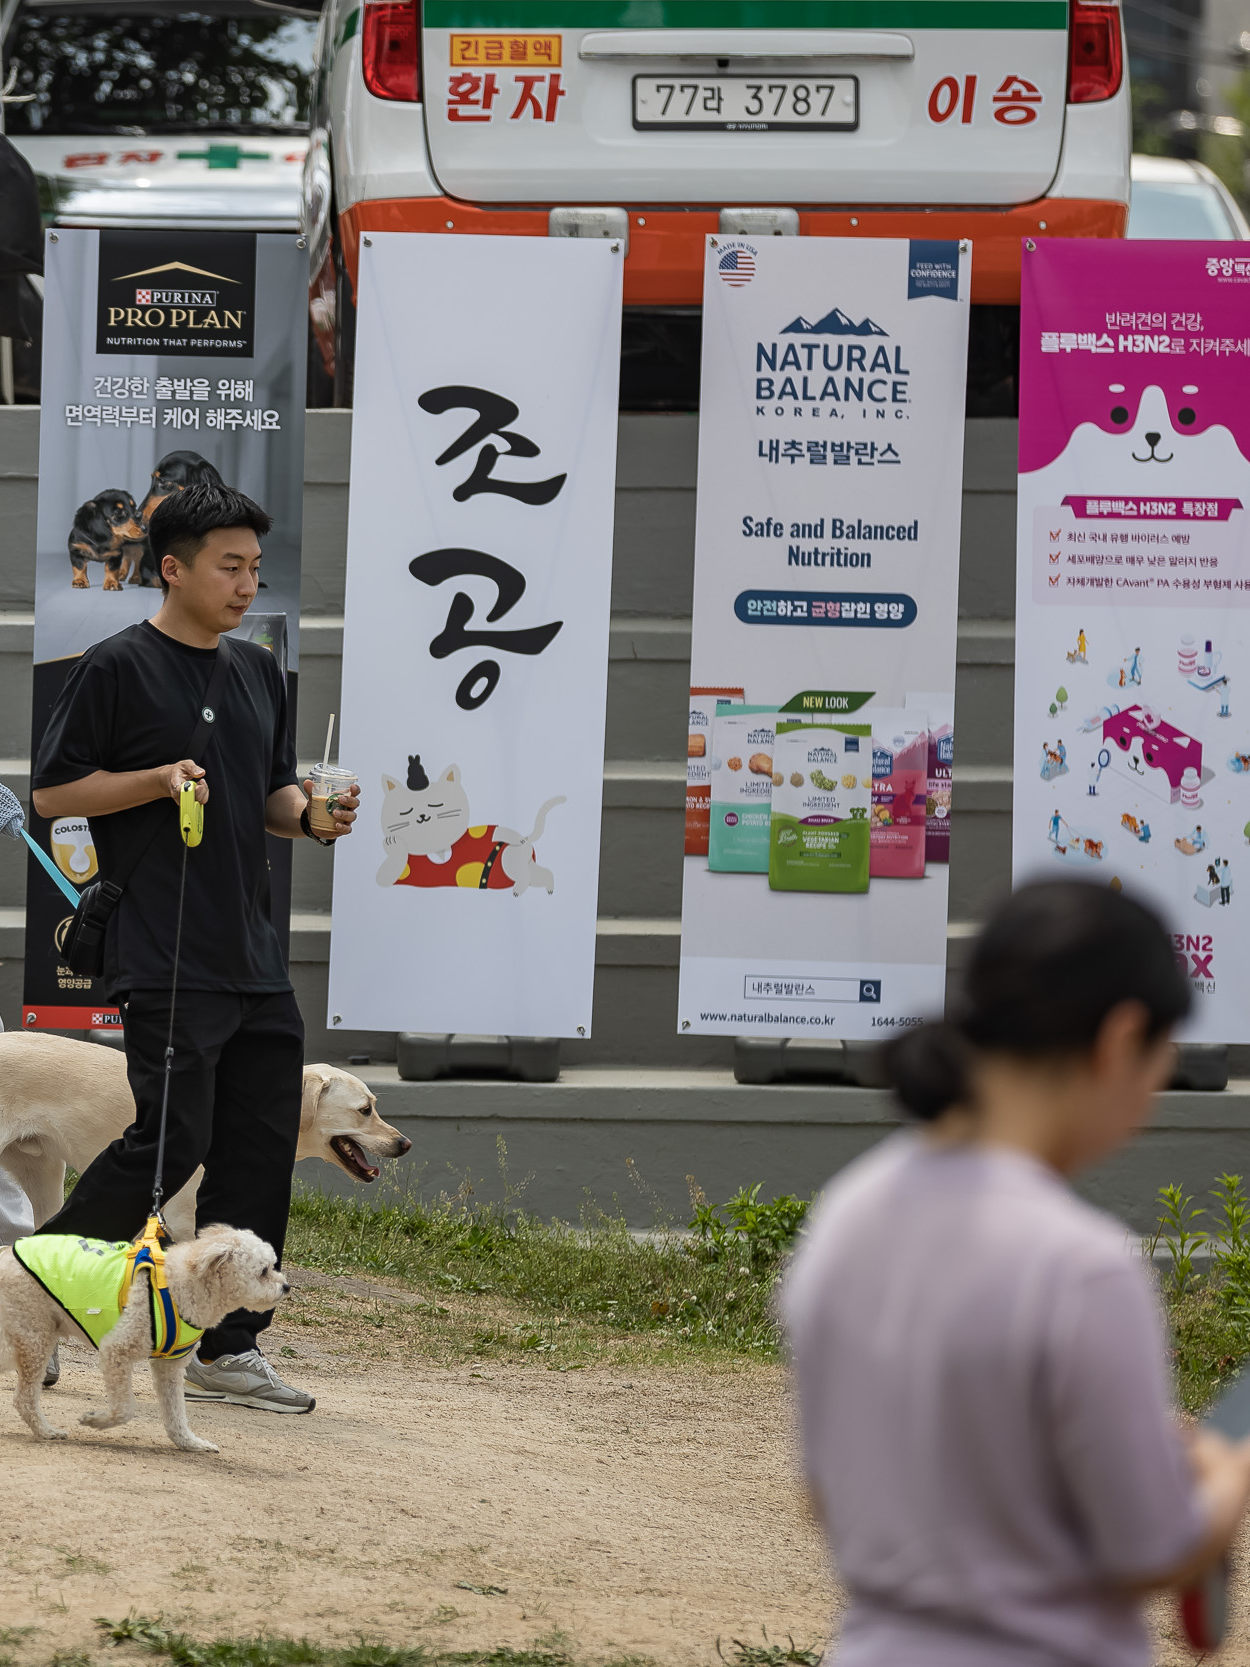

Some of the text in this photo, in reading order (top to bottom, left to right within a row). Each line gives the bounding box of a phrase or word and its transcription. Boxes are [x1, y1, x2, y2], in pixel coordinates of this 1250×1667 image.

[459, 38, 553, 62] 긴급혈액
[655, 84, 836, 117] 77라 3787
[716, 242, 736, 256] MADE
[745, 243, 759, 257] USA
[916, 262, 952, 270] FEED WITH
[910, 269, 956, 279] CONFIDENCE
[152, 291, 213, 305] PURINA
[107, 307, 243, 329] PRO PLAN
[1105, 312, 1205, 332] 반려견의 건강,
[106, 336, 160, 347] NUTRITION
[162, 338, 188, 347] THAT
[1040, 331, 1115, 353] 플루백스
[1118, 334, 1186, 355] H3N2로
[755, 342, 910, 375] NATURAL
[93, 376, 254, 402] 건강한 출발을 위해
[755, 377, 909, 404] BALANCE
[64, 404, 281, 432] 면역력부터 케어 해주세요
[755, 406, 910, 420] KOREA, INC.
[758, 439, 901, 466] 내추럴발란스
[1085, 499, 1219, 517] 플루백스 H3N2 특장점
[742, 515, 919, 542] Safe and Balanced
[1066, 531, 1191, 545] 최신 국내 유행 바이러스 예방
[408, 384, 567, 711] 조공
[787, 545, 872, 568] Nutrition
[1066, 554, 1219, 568] 세포배양으로 매우 낮은 알러지 반응
[1066, 576, 1113, 589] 자체개발한
[1156, 577, 1170, 588] PA
[747, 599, 905, 620] 안전하고 균형잡힌 영양
[802, 695, 849, 709] NEW LOOK
[872, 783, 893, 792] TRA
[54, 824, 90, 835] COLOST
[802, 836, 840, 844] VEGETARIAN
[57, 978, 93, 990] 영양공급
[751, 981, 816, 996] 내추럴발란스
[104, 1014, 123, 1024] PU
[700, 1011, 924, 1027] www.naturalbalance.co.kr 1644-5055
